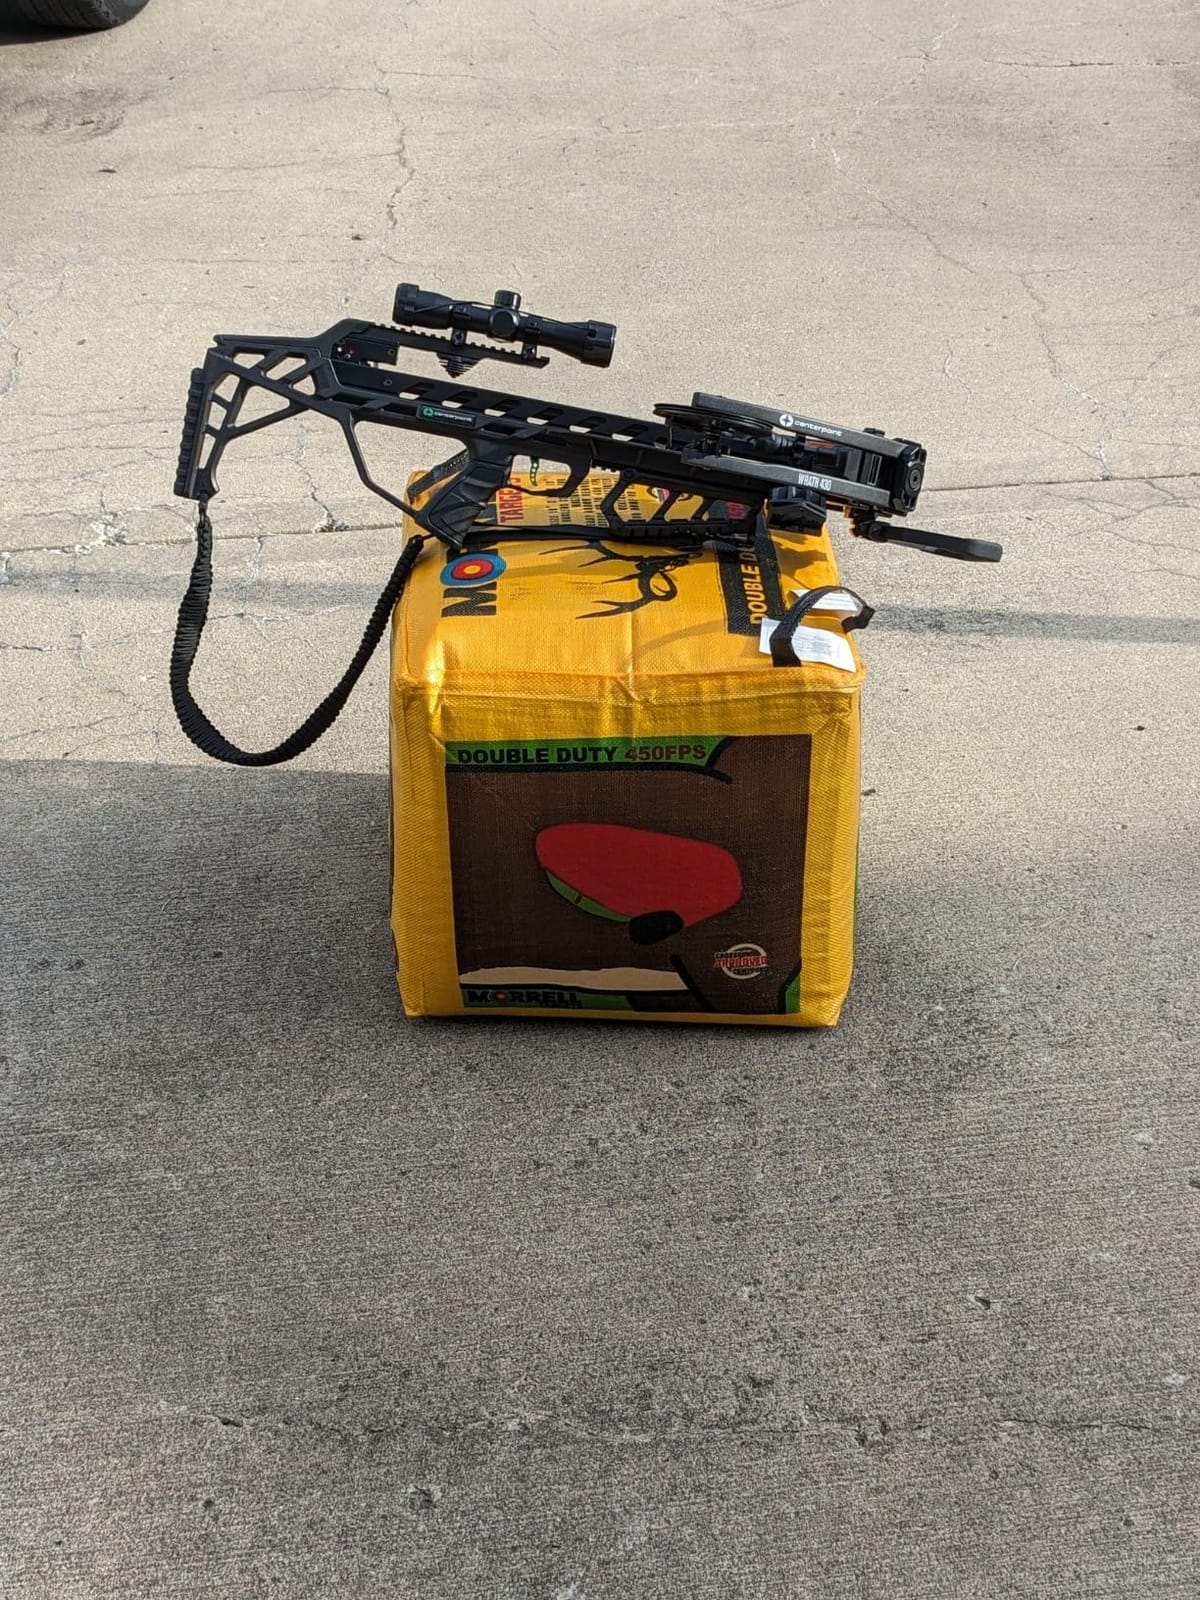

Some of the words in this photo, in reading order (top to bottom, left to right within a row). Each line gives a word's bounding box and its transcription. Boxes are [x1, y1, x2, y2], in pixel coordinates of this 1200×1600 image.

[798, 473, 820, 489] WRATH
[819, 477, 833, 491] 430
[457, 747, 549, 764] DOUBLE
[556, 746, 618, 762] DUTY
[624, 744, 707, 761] 450FPS
